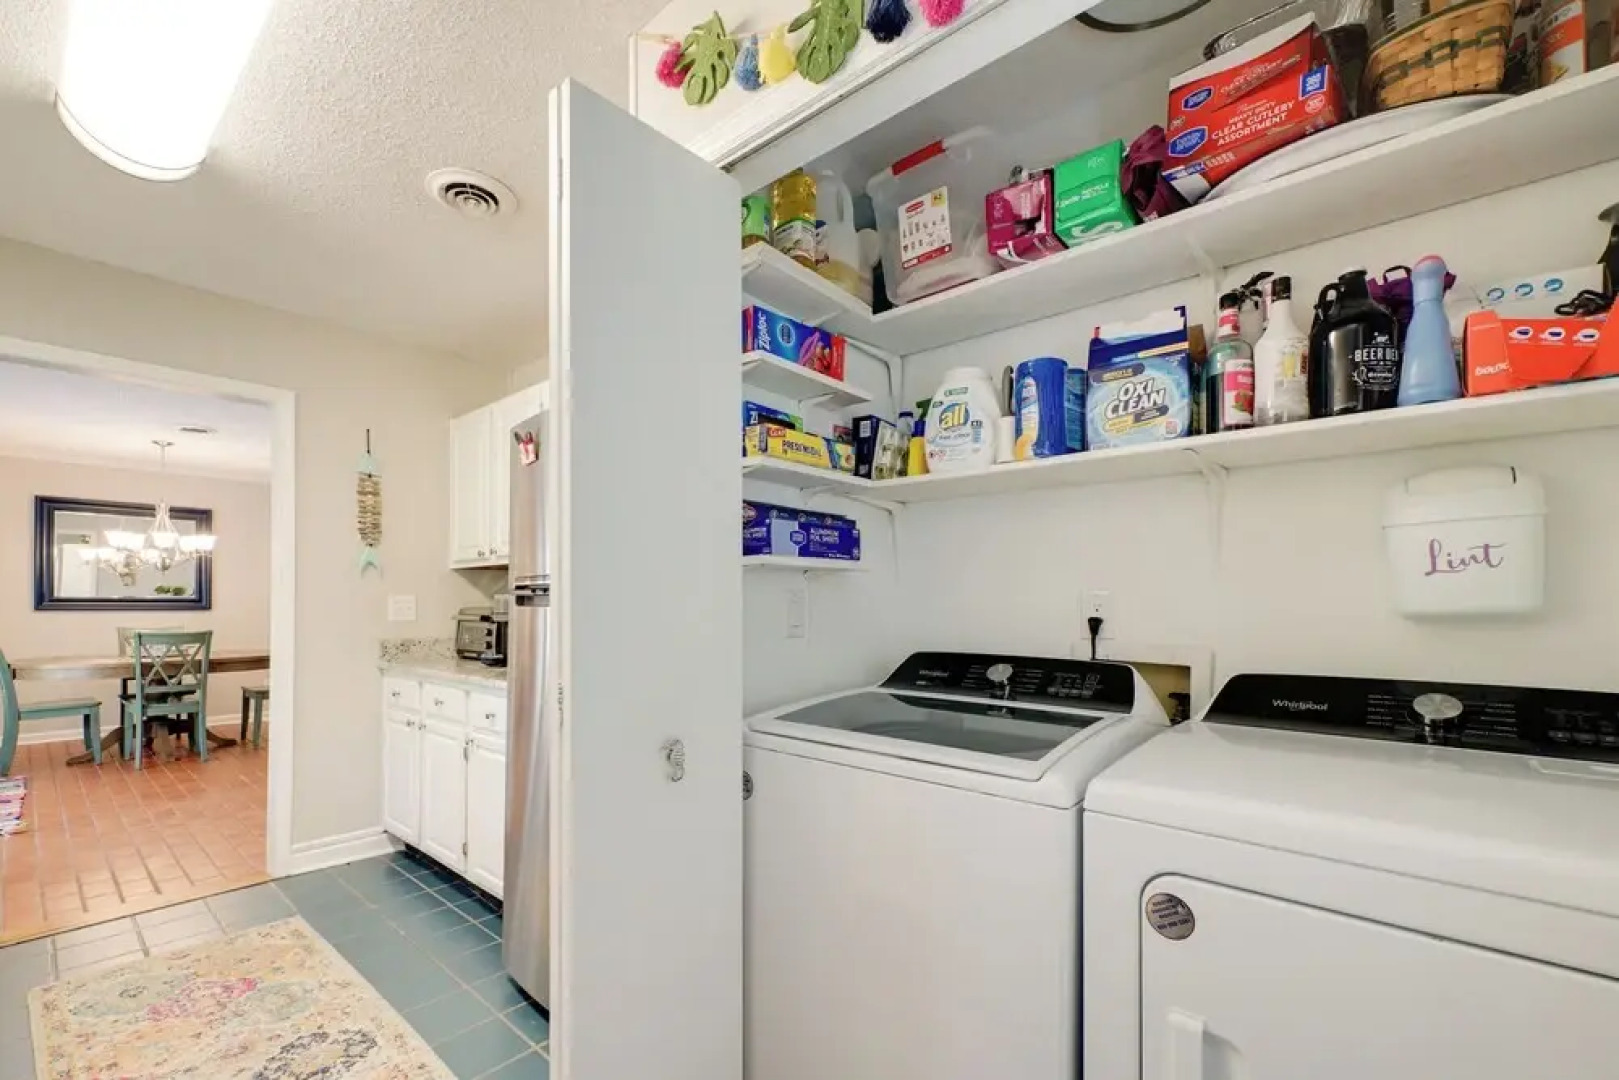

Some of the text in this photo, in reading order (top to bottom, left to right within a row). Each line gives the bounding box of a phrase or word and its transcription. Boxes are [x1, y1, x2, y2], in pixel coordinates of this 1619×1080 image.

[1211, 120, 1244, 139] CLEAR
[1246, 100, 1295, 127] CUTLERY
[1217, 111, 1288, 146] ASSORTMENT
[758, 310, 771, 351] Ziploc
[1354, 347, 1384, 362] BEER
[1105, 387, 1166, 420] CLEAN
[1118, 377, 1155, 401] OXI
[941, 403, 966, 429] all
[1424, 538, 1508, 576] Lint
[1272, 699, 1328, 711] Whirlpool
